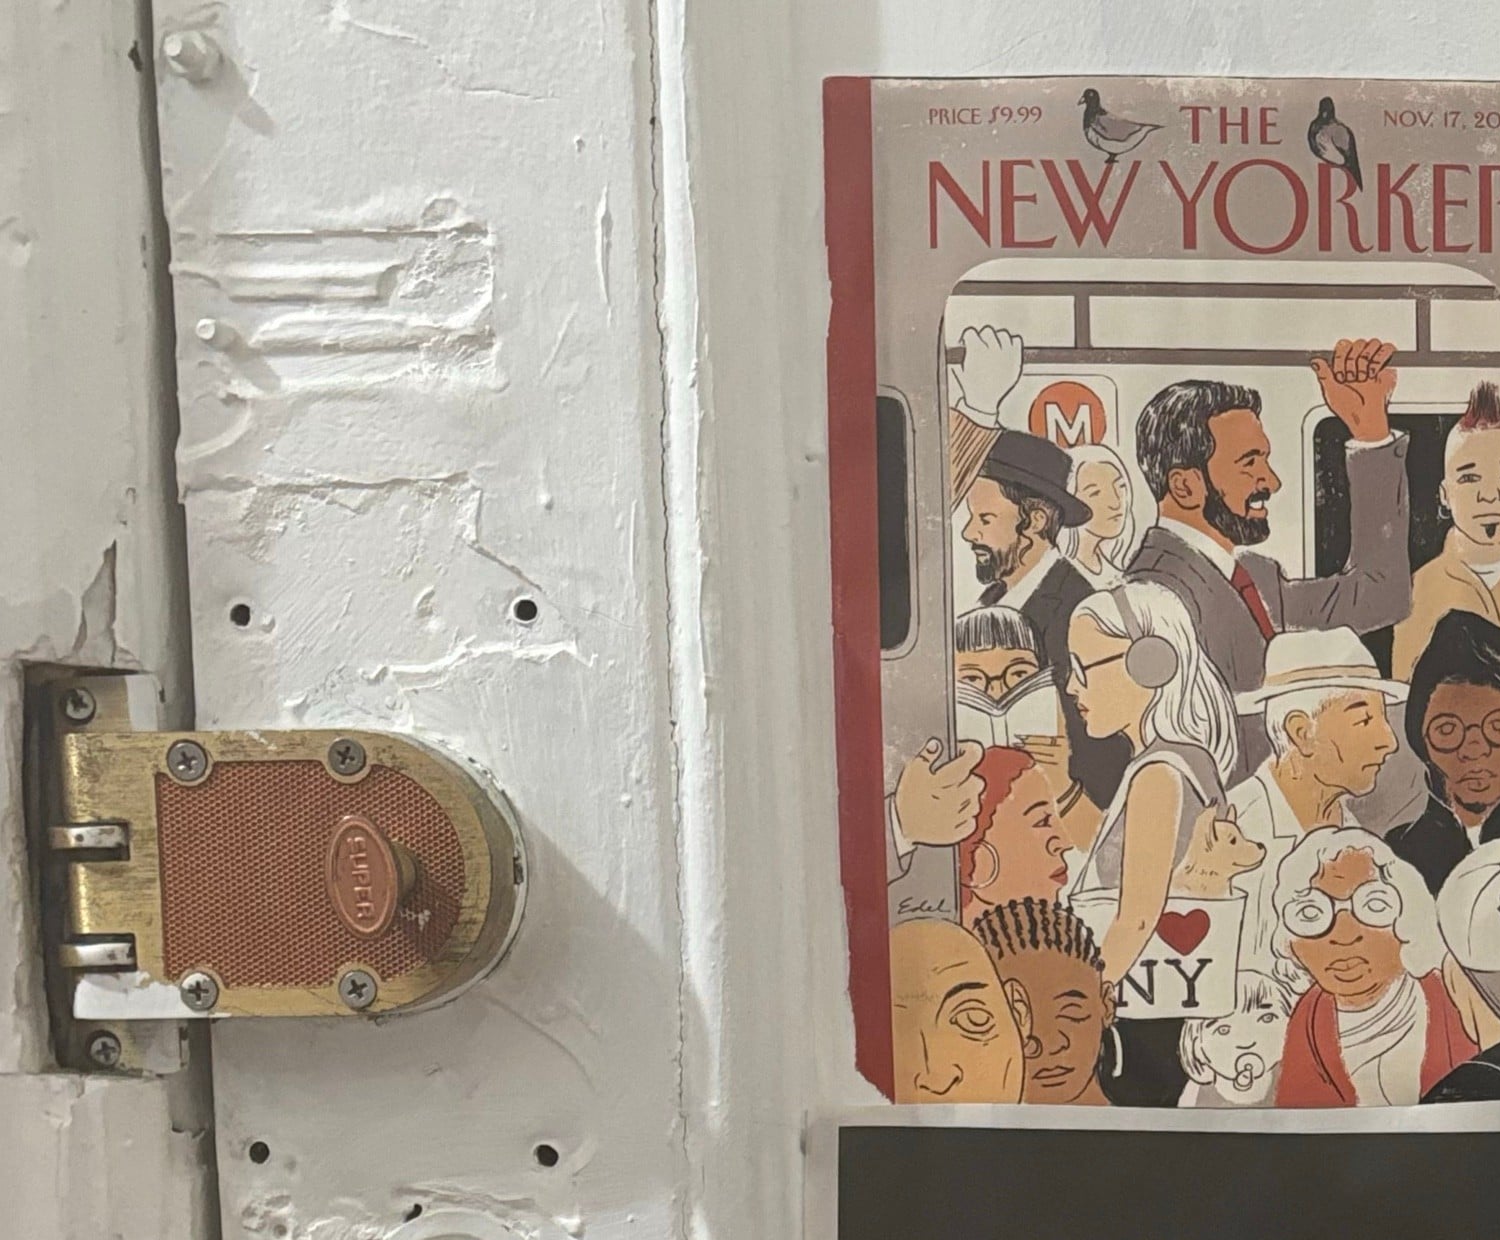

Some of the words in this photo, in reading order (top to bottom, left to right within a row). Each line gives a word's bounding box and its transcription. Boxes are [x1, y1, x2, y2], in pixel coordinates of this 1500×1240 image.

[928, 107, 982, 125] PRICE
[1179, 105, 1283, 146] THE
[1383, 109, 1434, 129] NOV.
[1443, 110, 1466, 130] 17,
[928, 158, 1142, 250] NEW
[1044, 401, 1095, 449] M
[1116, 958, 1213, 1009] NY
